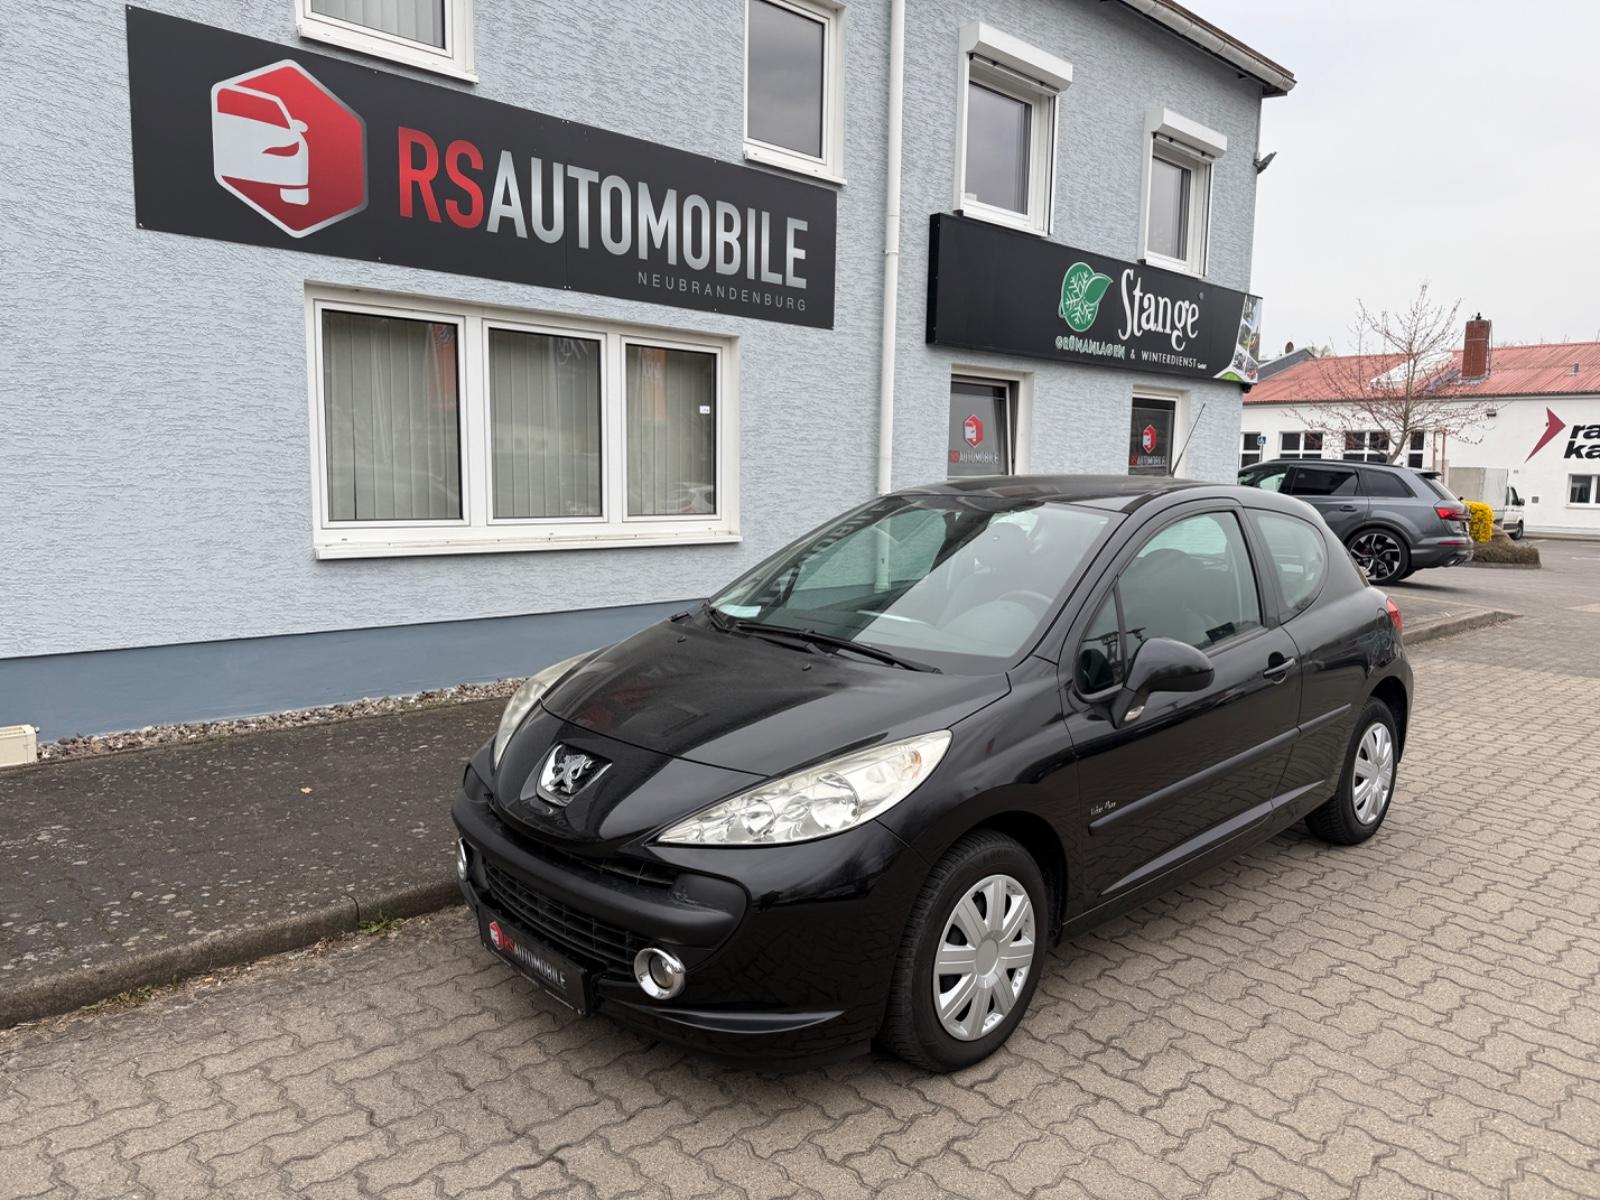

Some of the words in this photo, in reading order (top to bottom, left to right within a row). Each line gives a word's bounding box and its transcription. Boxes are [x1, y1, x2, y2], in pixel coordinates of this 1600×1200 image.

[637, 270, 808, 313] NEUBRANDENBURG
[1118, 268, 1200, 352] Stange
[1055, 335, 1126, 360] GRÜNANLAGEN
[1130, 349, 1136, 360] &
[1141, 350, 1198, 368] WINTERDIENST
